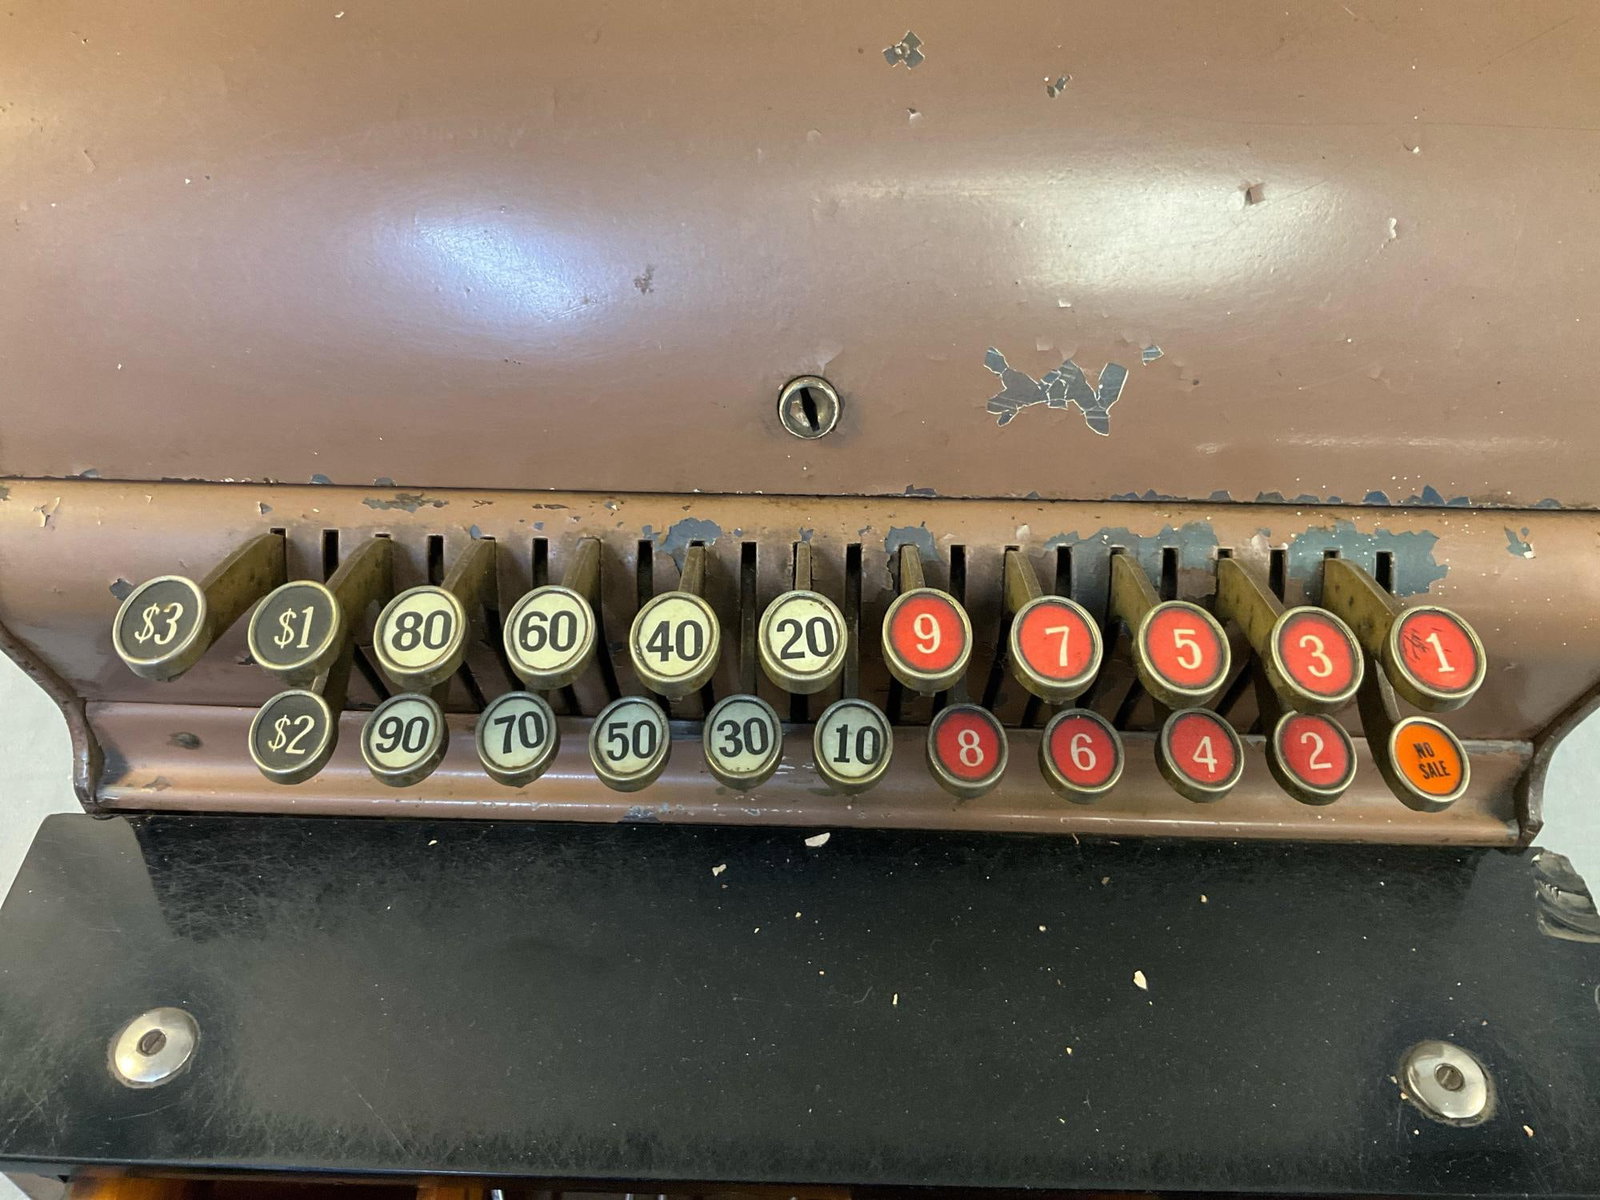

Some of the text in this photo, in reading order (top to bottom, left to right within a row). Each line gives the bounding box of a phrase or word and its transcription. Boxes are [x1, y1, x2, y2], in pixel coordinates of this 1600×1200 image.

[134, 602, 182, 646] $3
[273, 606, 315, 650] $1
[391, 610, 453, 652] 80
[517, 610, 578, 653] 60
[645, 620, 704, 662] 40
[777, 618, 836, 661] 20
[913, 613, 941, 654] 9
[1044, 625, 1071, 667] 7
[1175, 629, 1203, 670] 5
[1299, 634, 1334, 677] 3
[1426, 632, 1455, 673] 1
[268, 715, 315, 755] $2
[375, 716, 430, 753] 90
[494, 711, 545, 754] 70
[606, 720, 657, 761] 50
[716, 716, 769, 757] 30
[832, 723, 878, 764] 10
[957, 729, 985, 766] 8
[1070, 733, 1096, 771] 6
[1300, 732, 1332, 770] 2
[1413, 742, 1433, 758] NO
[1192, 736, 1218, 773] 4
[1417, 759, 1452, 779] SALE
